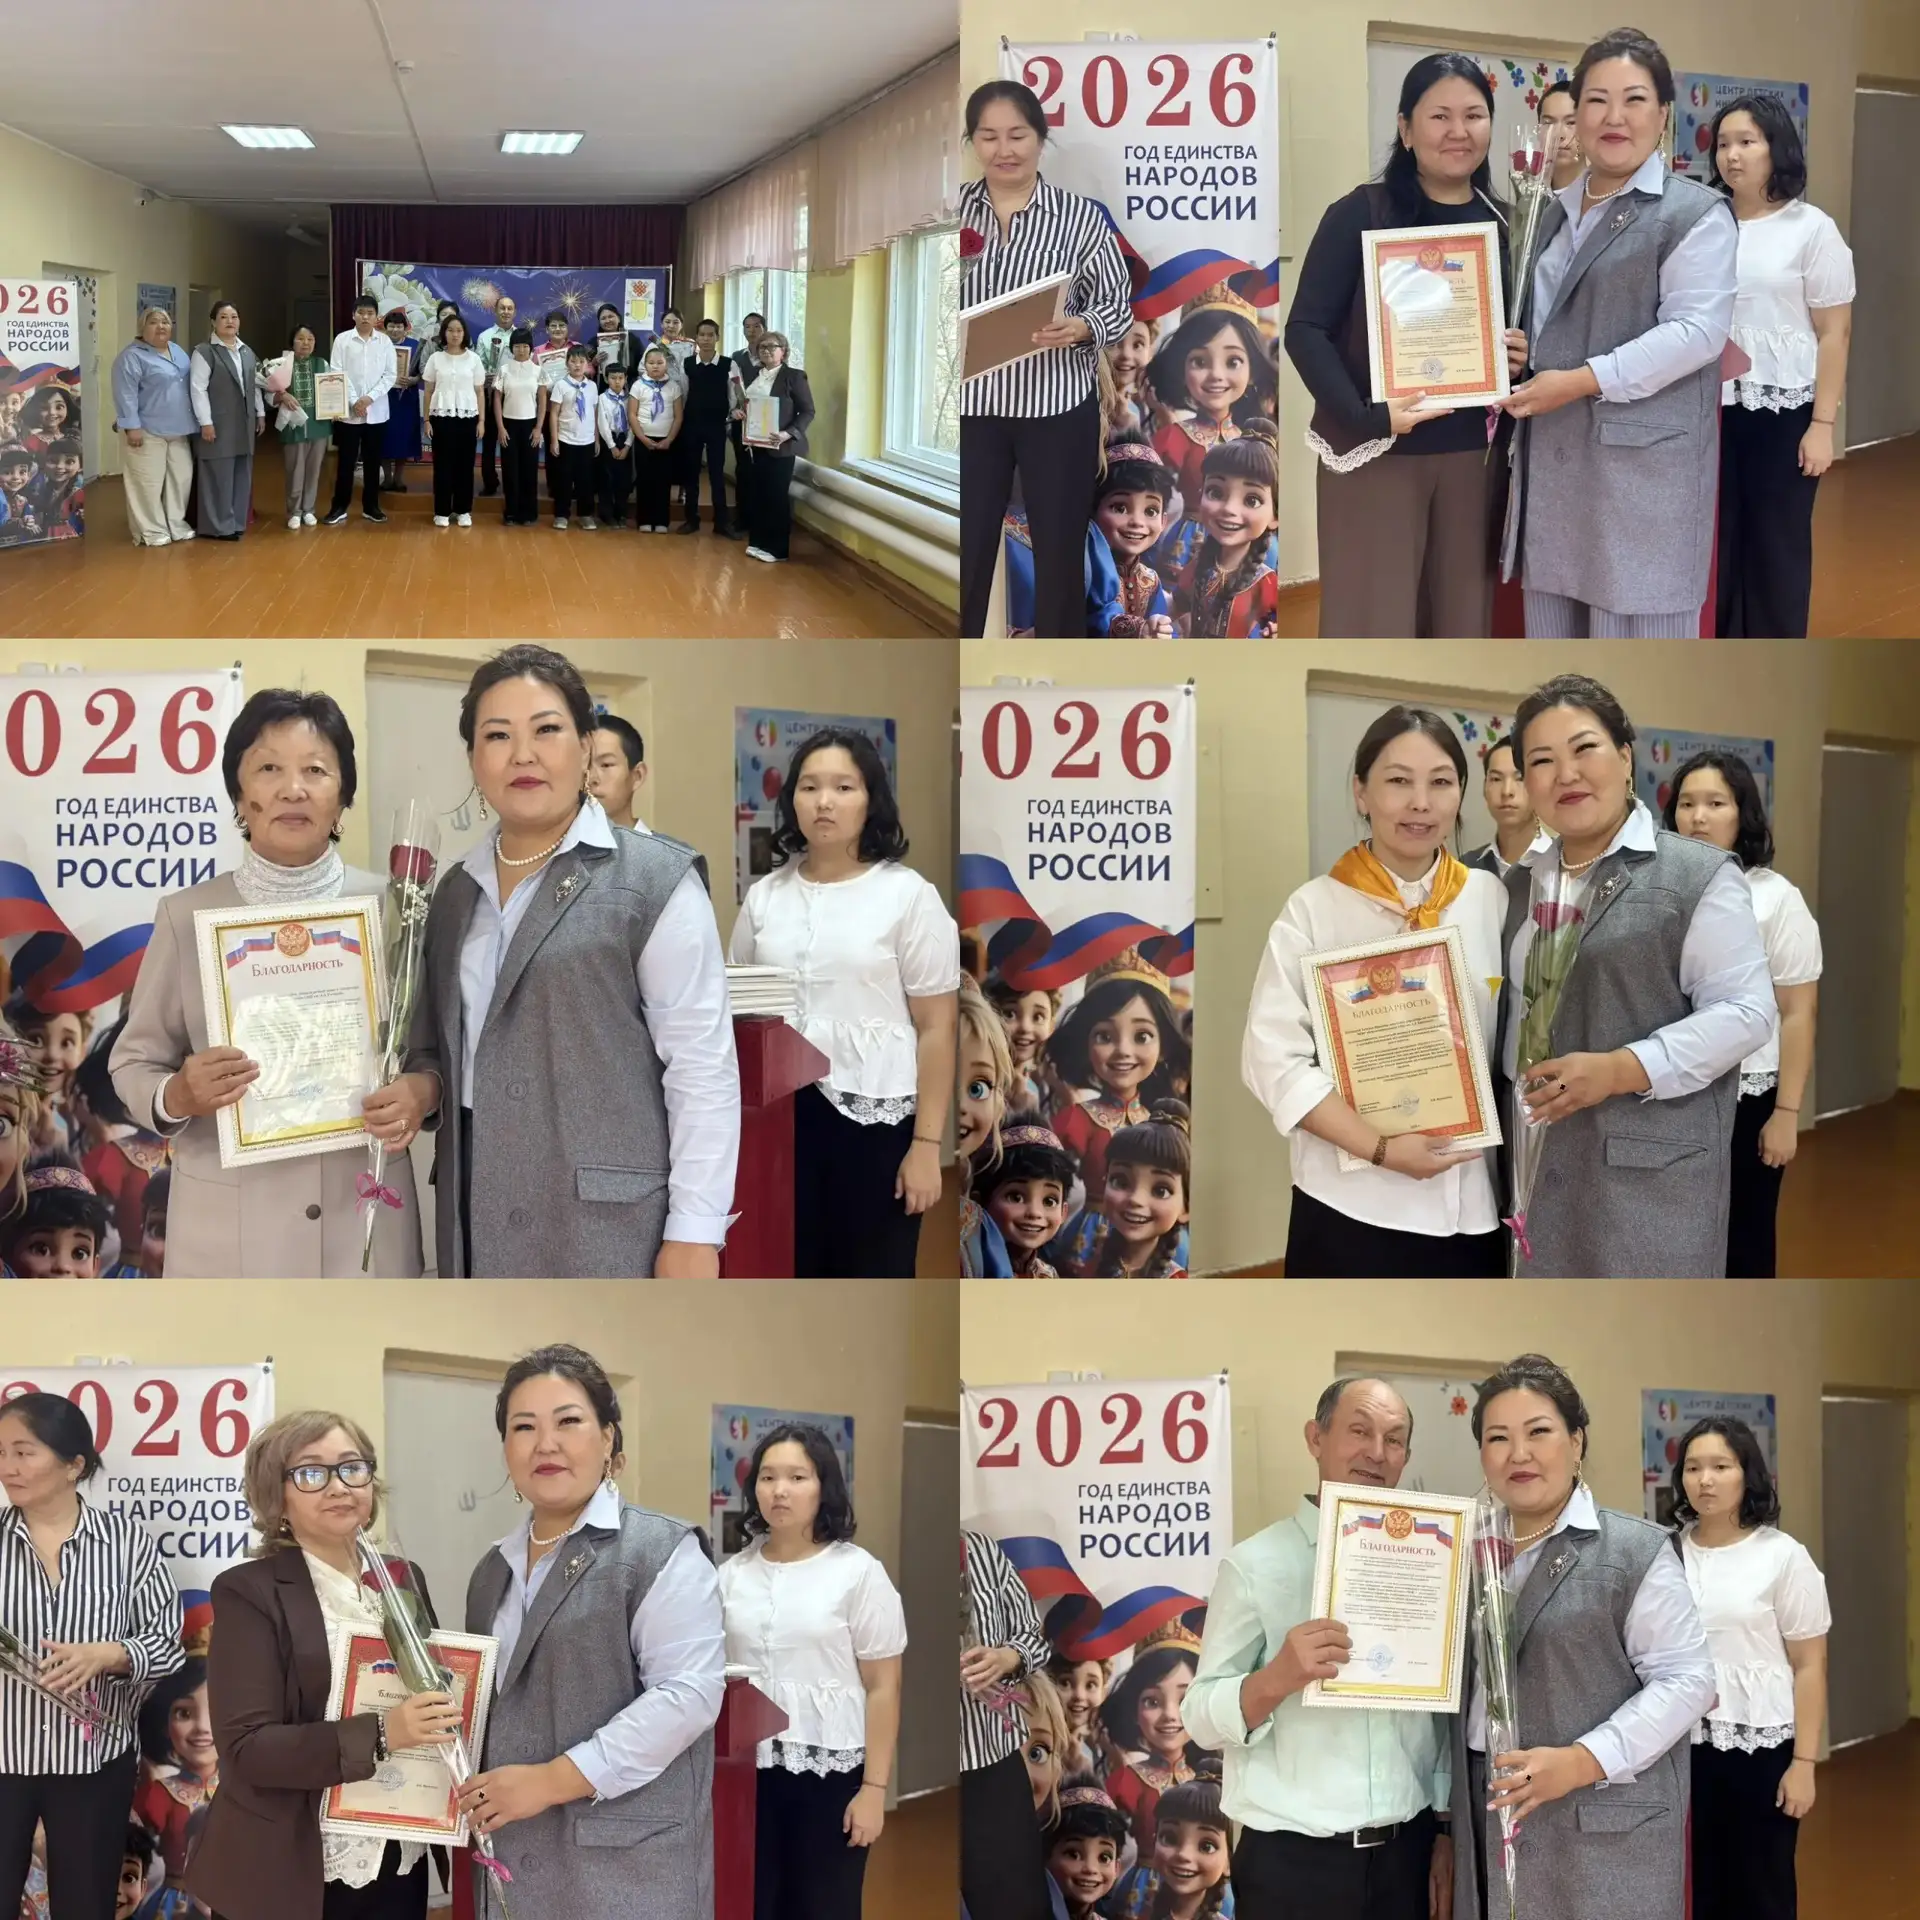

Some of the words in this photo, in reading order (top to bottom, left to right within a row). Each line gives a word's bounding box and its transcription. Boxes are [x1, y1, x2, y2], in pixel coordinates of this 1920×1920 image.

[1022, 53, 1257, 128] 2026
[1124, 145, 1160, 163] ГОД
[1164, 145, 1258, 163] ЕДИНСТВА
[1125, 166, 1258, 191] НАРОДОВ
[1126, 195, 1257, 220] РОССИИ
[7, 320, 25, 328] ГОД
[26, 320, 69, 328] ЕДИНСТВА
[7, 329, 69, 340] НАРОДОВ
[8, 341, 69, 352] РОССИИ
[5, 686, 217, 777] 026
[960, 700, 1172, 780] 026
[56, 798, 98, 819] ГОД
[104, 796, 218, 818] ЕДИНСТВА
[1027, 799, 1065, 818] ГОД
[1071, 799, 1173, 818] ЕДИНСТВА
[56, 822, 218, 853] НАРОДОВ
[1028, 822, 1172, 849] НАРОДОВ
[57, 858, 216, 889] РОССИИ
[1029, 854, 1171, 881] РОССИИ
[1, 1379, 250, 1458] 026
[976, 1390, 1209, 1467] 2026
[108, 1477, 146, 1496] ГОД
[1078, 1484, 1113, 1501] ГОД
[1118, 1481, 1211, 1500] ЕДИНСТВА
[109, 1499, 251, 1527] НАРОДОВ
[1079, 1502, 1210, 1528] НАРОДОВ
[157, 1531, 250, 1558] ССИИ
[1080, 1531, 1210, 1559] РОССИИ
